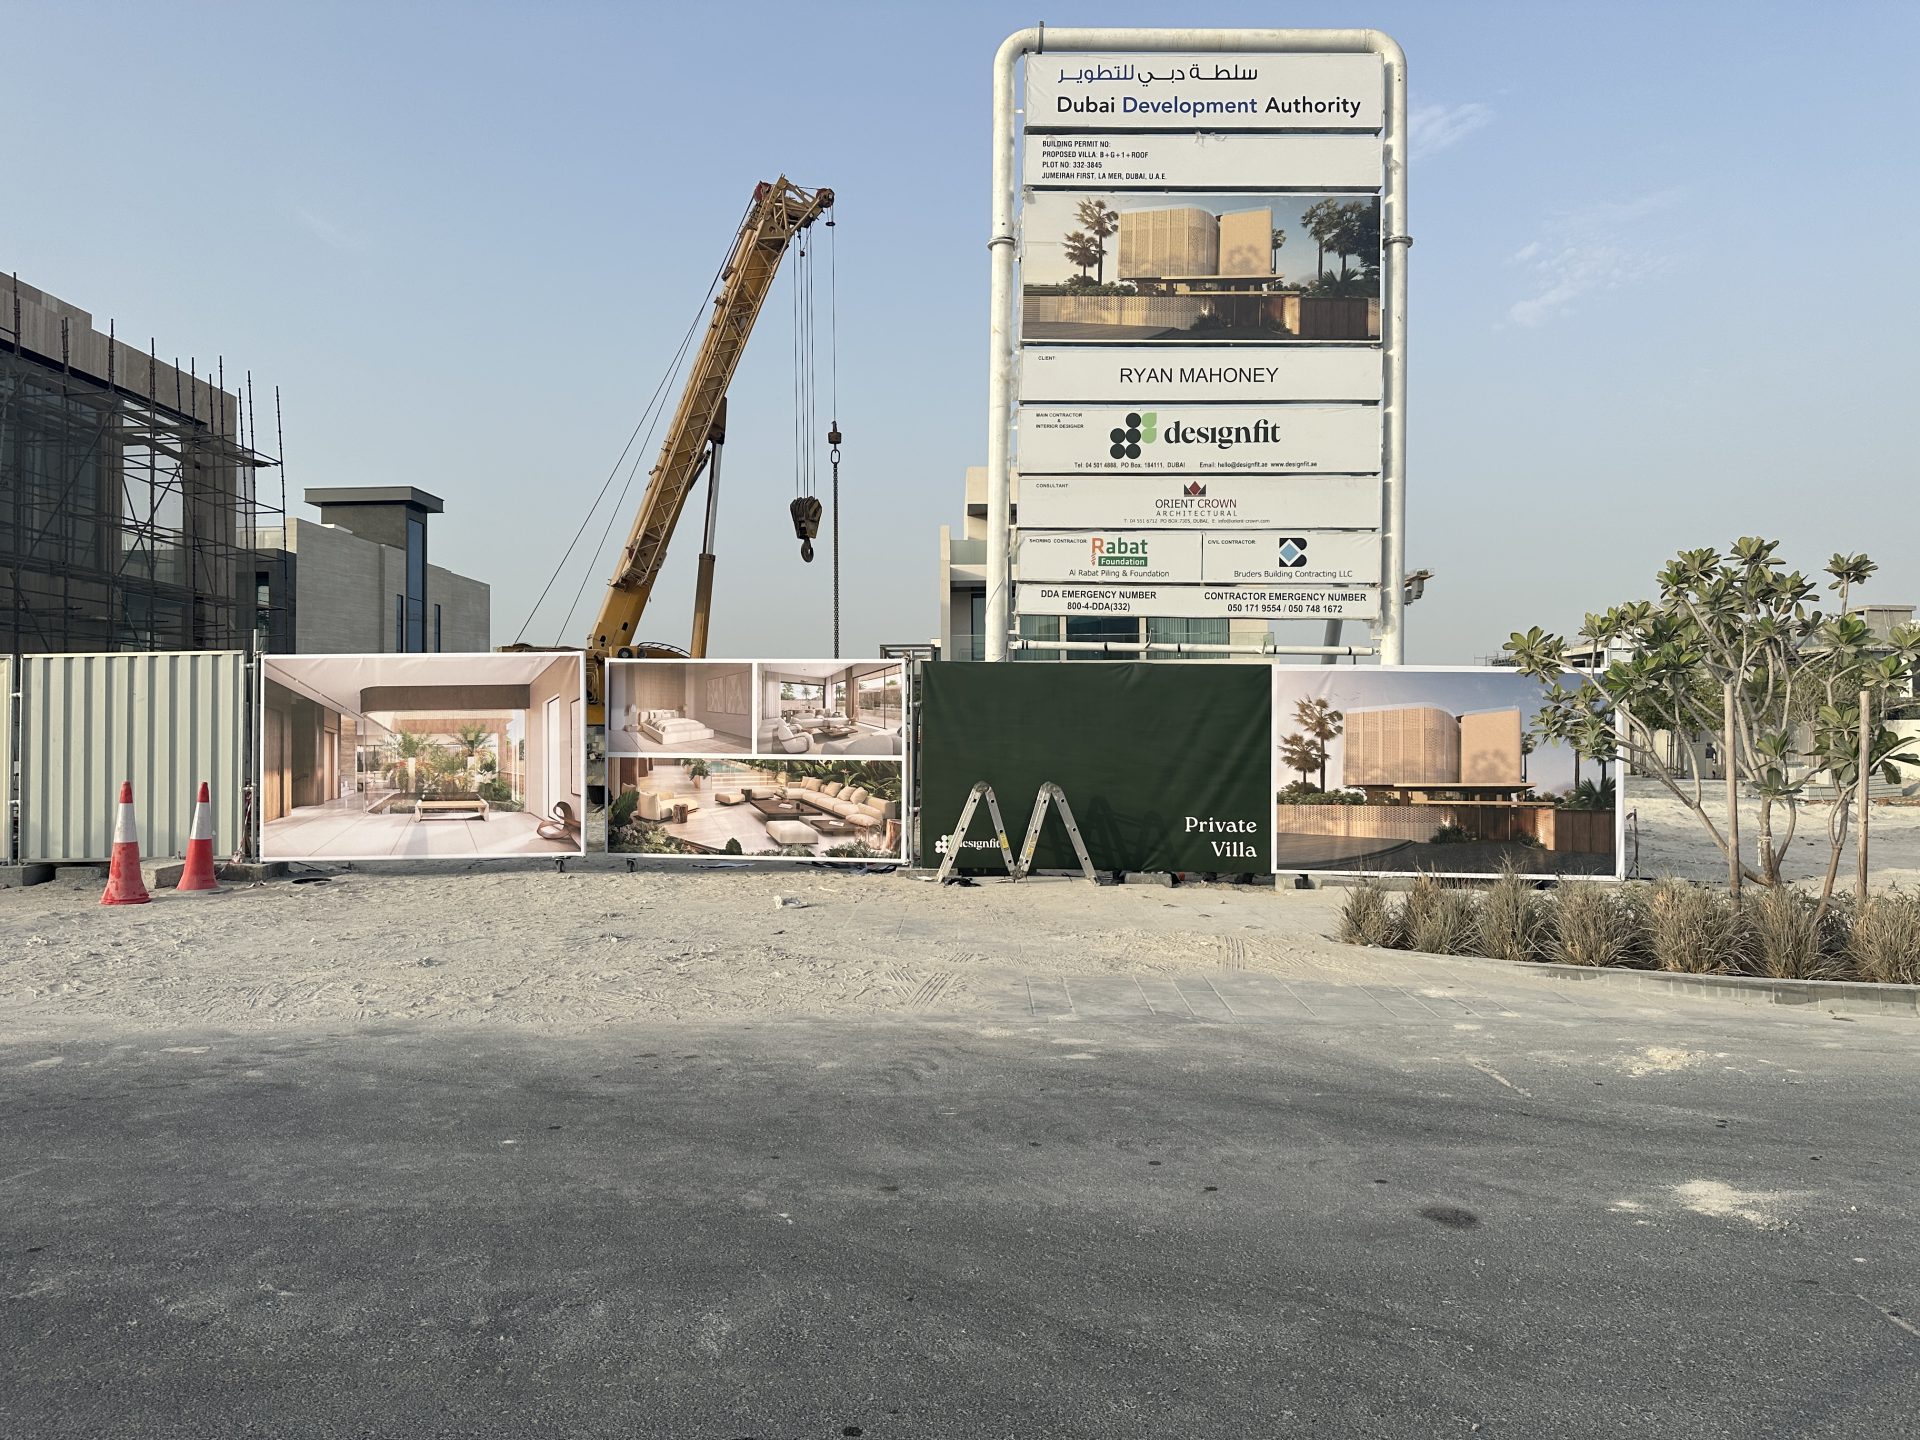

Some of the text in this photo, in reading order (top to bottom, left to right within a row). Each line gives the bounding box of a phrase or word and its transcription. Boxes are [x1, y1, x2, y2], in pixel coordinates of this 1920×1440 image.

[1057, 64, 1135, 84] للتطوير
[1137, 68, 1186, 87] دبي
[1057, 96, 1361, 118] Dubai Development Authority
[1120, 367, 1279, 383] RYAN MAHONEY
[1164, 419, 1281, 449] designfit
[1155, 499, 1237, 508] ORIENT CROWN
[1092, 537, 1148, 554] Rabat
[1102, 570, 1120, 578] Piling
[1264, 570, 1292, 578] Building
[1295, 570, 1337, 578] Contracting
[1062, 590, 1116, 599] EMERGENCY
[1119, 591, 1156, 599] NUMBER
[1204, 592, 1366, 602] CONTRACTOR EMERGENCY NUMBER
[1067, 602, 1131, 612] 800-4-DDA(332)
[1228, 604, 1242, 612] 050
[1245, 604, 1259, 612] 171
[1261, 604, 1281, 612] 9554
[1288, 604, 1303, 612] 050
[1305, 604, 1320, 612] 748
[1322, 604, 1343, 612] 1672
[1184, 816, 1257, 833] Private
[959, 838, 1001, 850] esignfit
[1211, 840, 1257, 858] Villa
